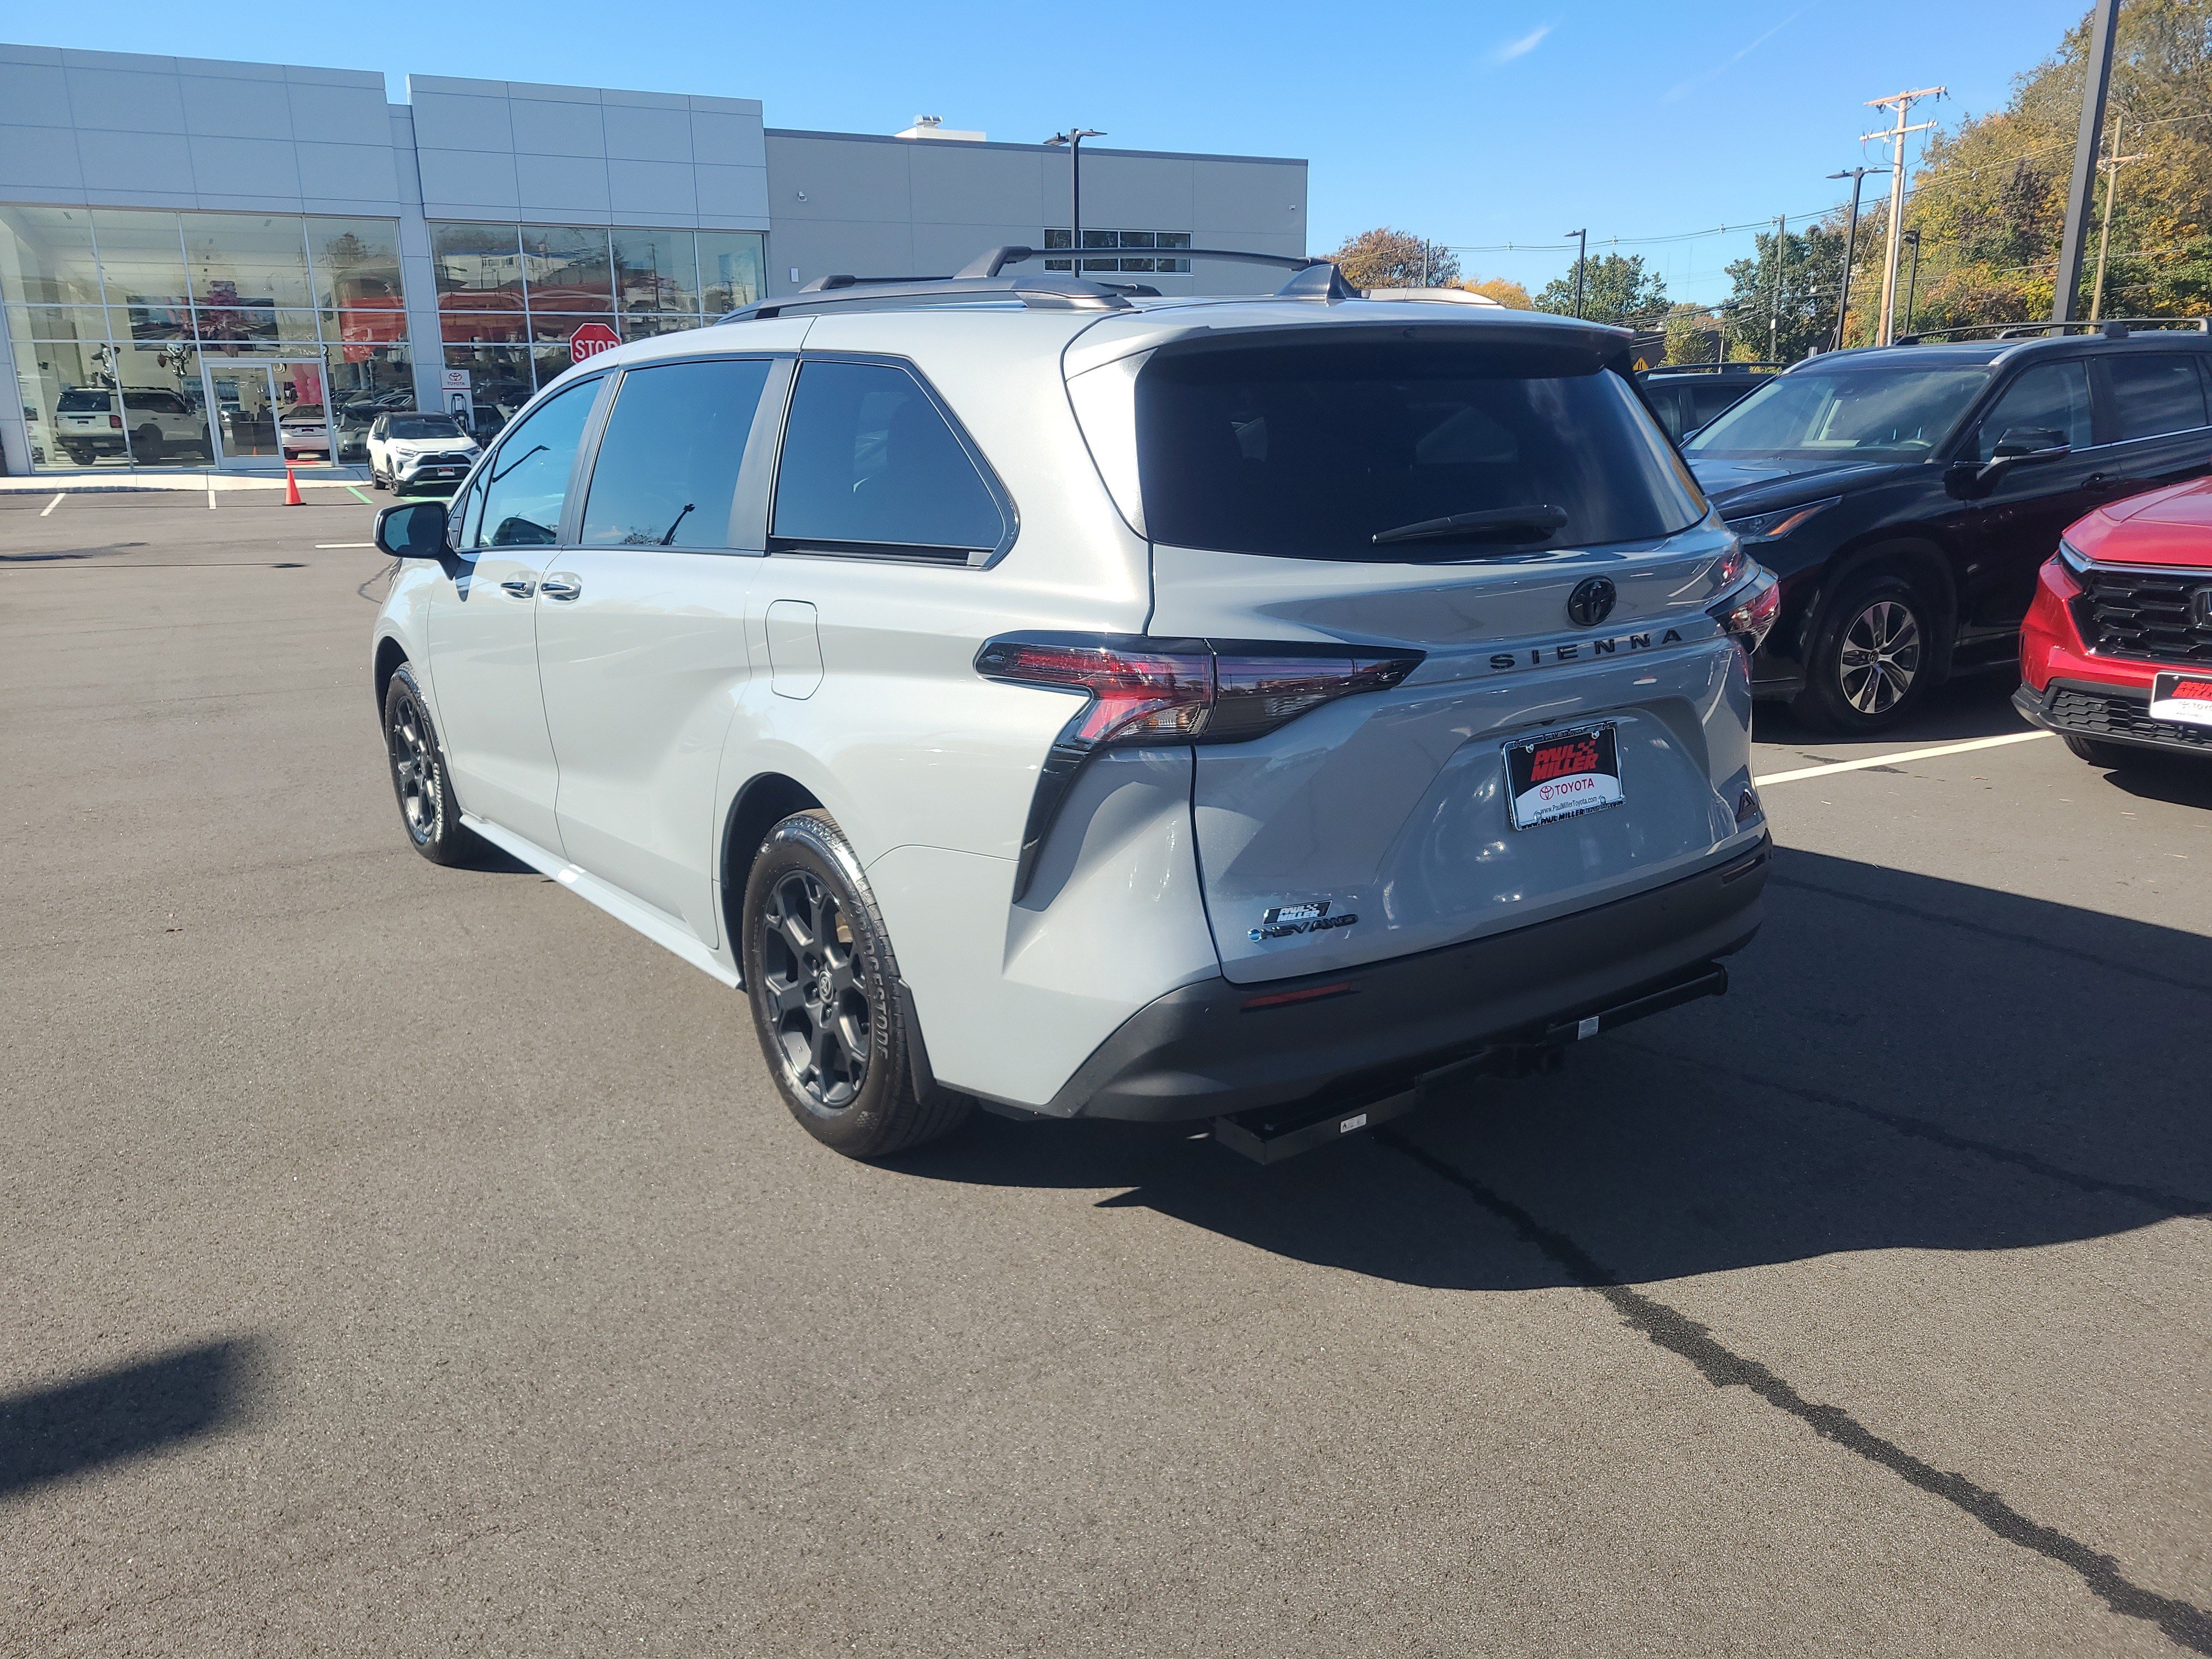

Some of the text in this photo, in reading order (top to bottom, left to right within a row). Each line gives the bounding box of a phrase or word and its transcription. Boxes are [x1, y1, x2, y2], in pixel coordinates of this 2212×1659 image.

[1489, 629, 1682, 669] SIENNA
[1534, 743, 1577, 765] PAUL
[1530, 752, 1599, 782] MILLER
[1555, 778, 1594, 795] TOYOTA
[1540, 796, 1597, 815] www.PaulMillerToyota.com
[1276, 910, 1320, 923] MILLER
[1279, 906, 1307, 915] PAUL
[1260, 913, 1358, 939] HEV AWD
